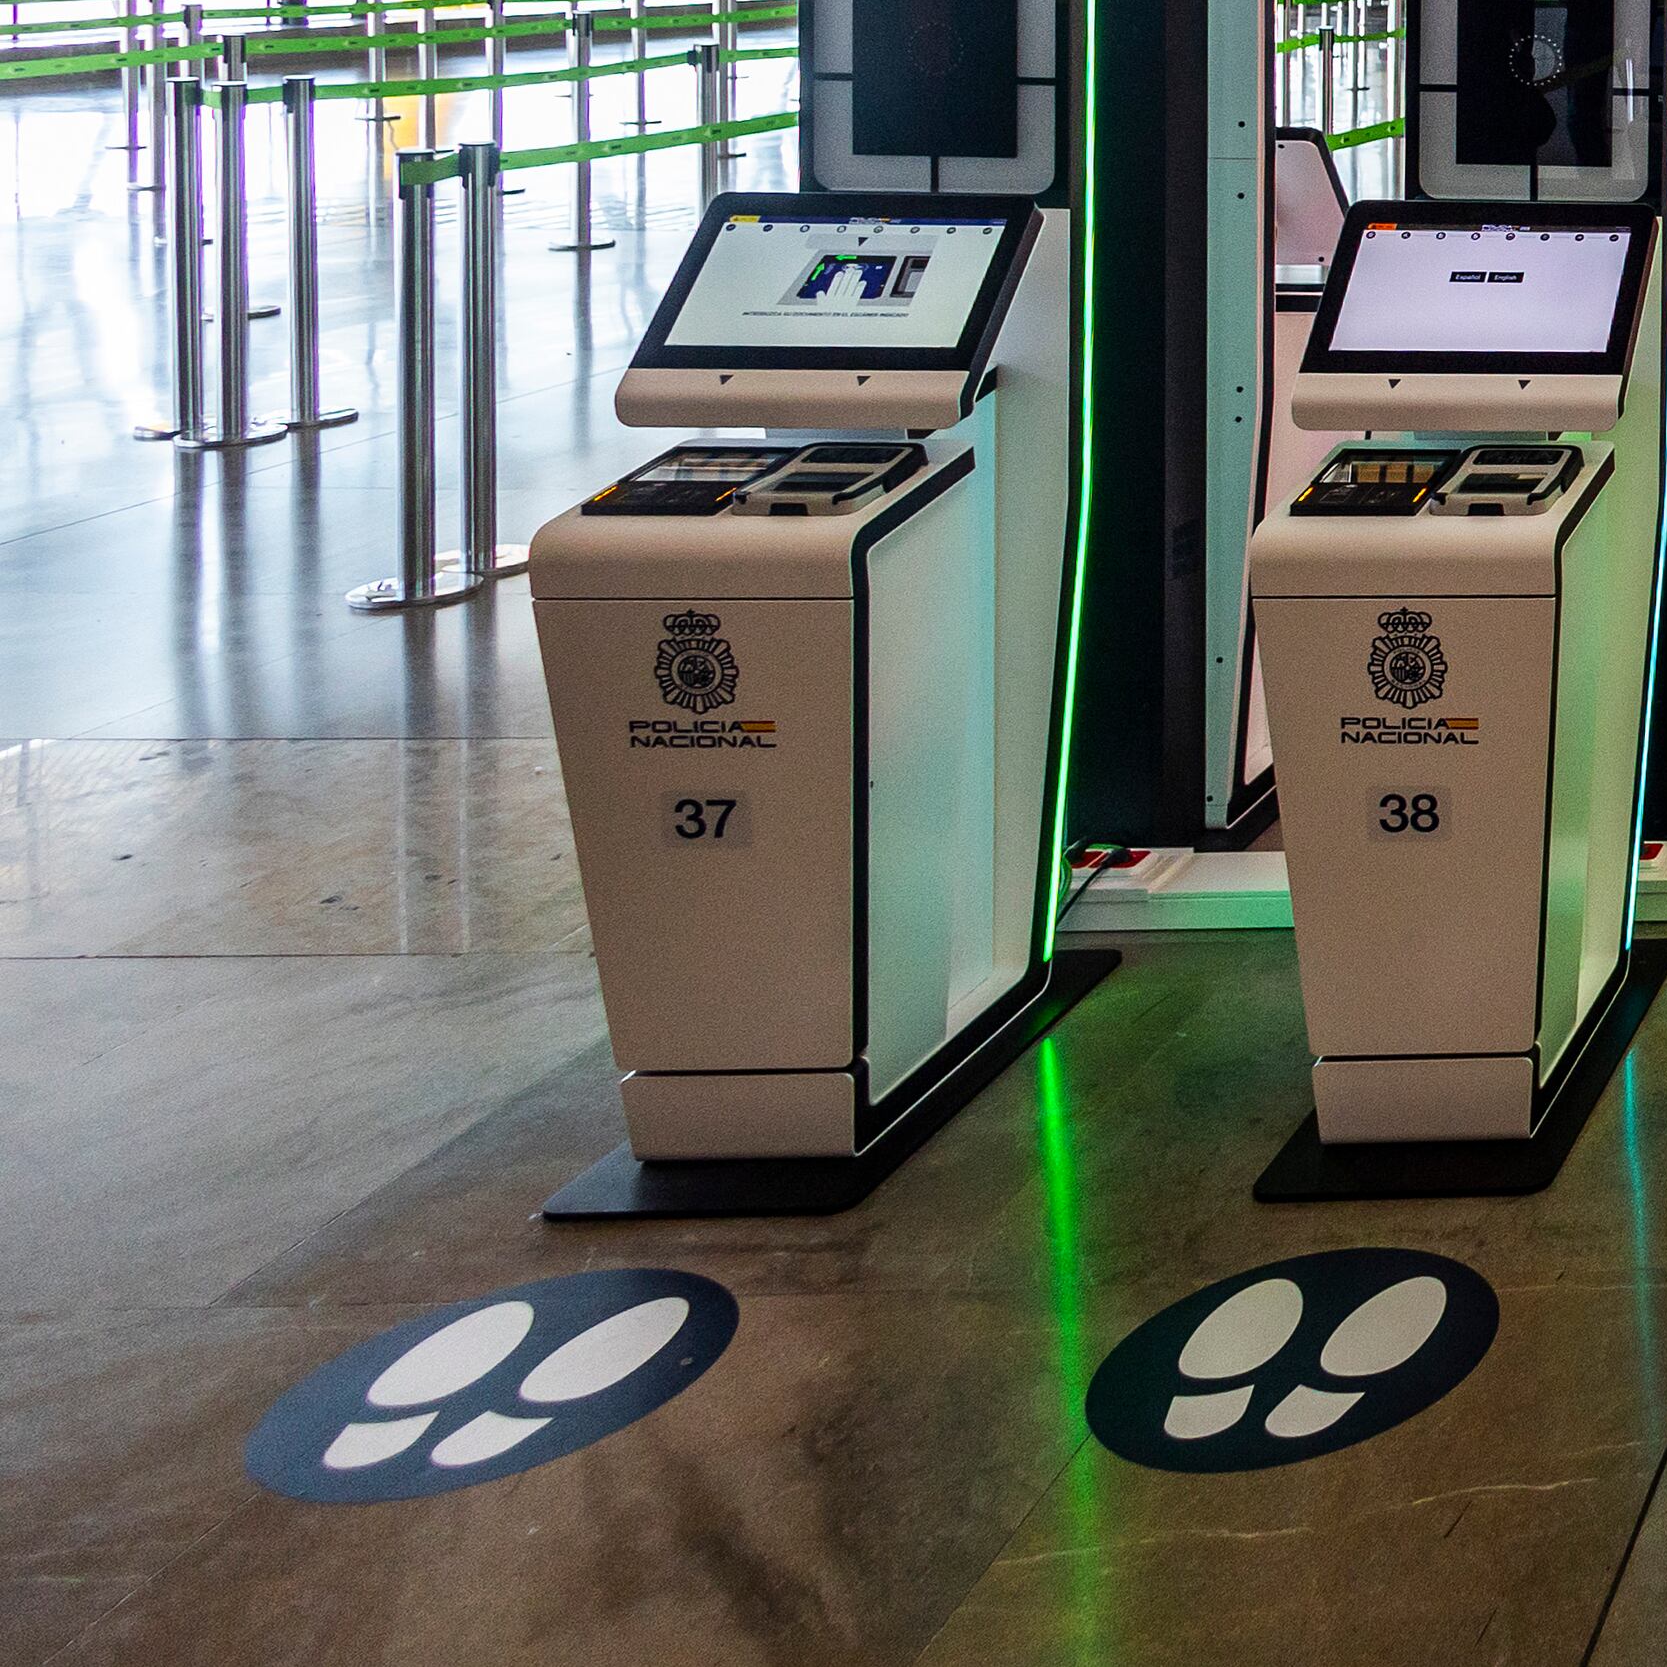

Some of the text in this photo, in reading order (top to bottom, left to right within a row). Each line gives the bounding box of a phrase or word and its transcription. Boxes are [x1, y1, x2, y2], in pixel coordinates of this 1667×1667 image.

[629, 720, 743, 733] POLICIA
[1340, 717, 1450, 729] POLICIA
[630, 735, 777, 748] NACIONAL
[1340, 731, 1479, 745] NACIONAL
[674, 798, 737, 839] 37
[1378, 793, 1440, 833] 38
